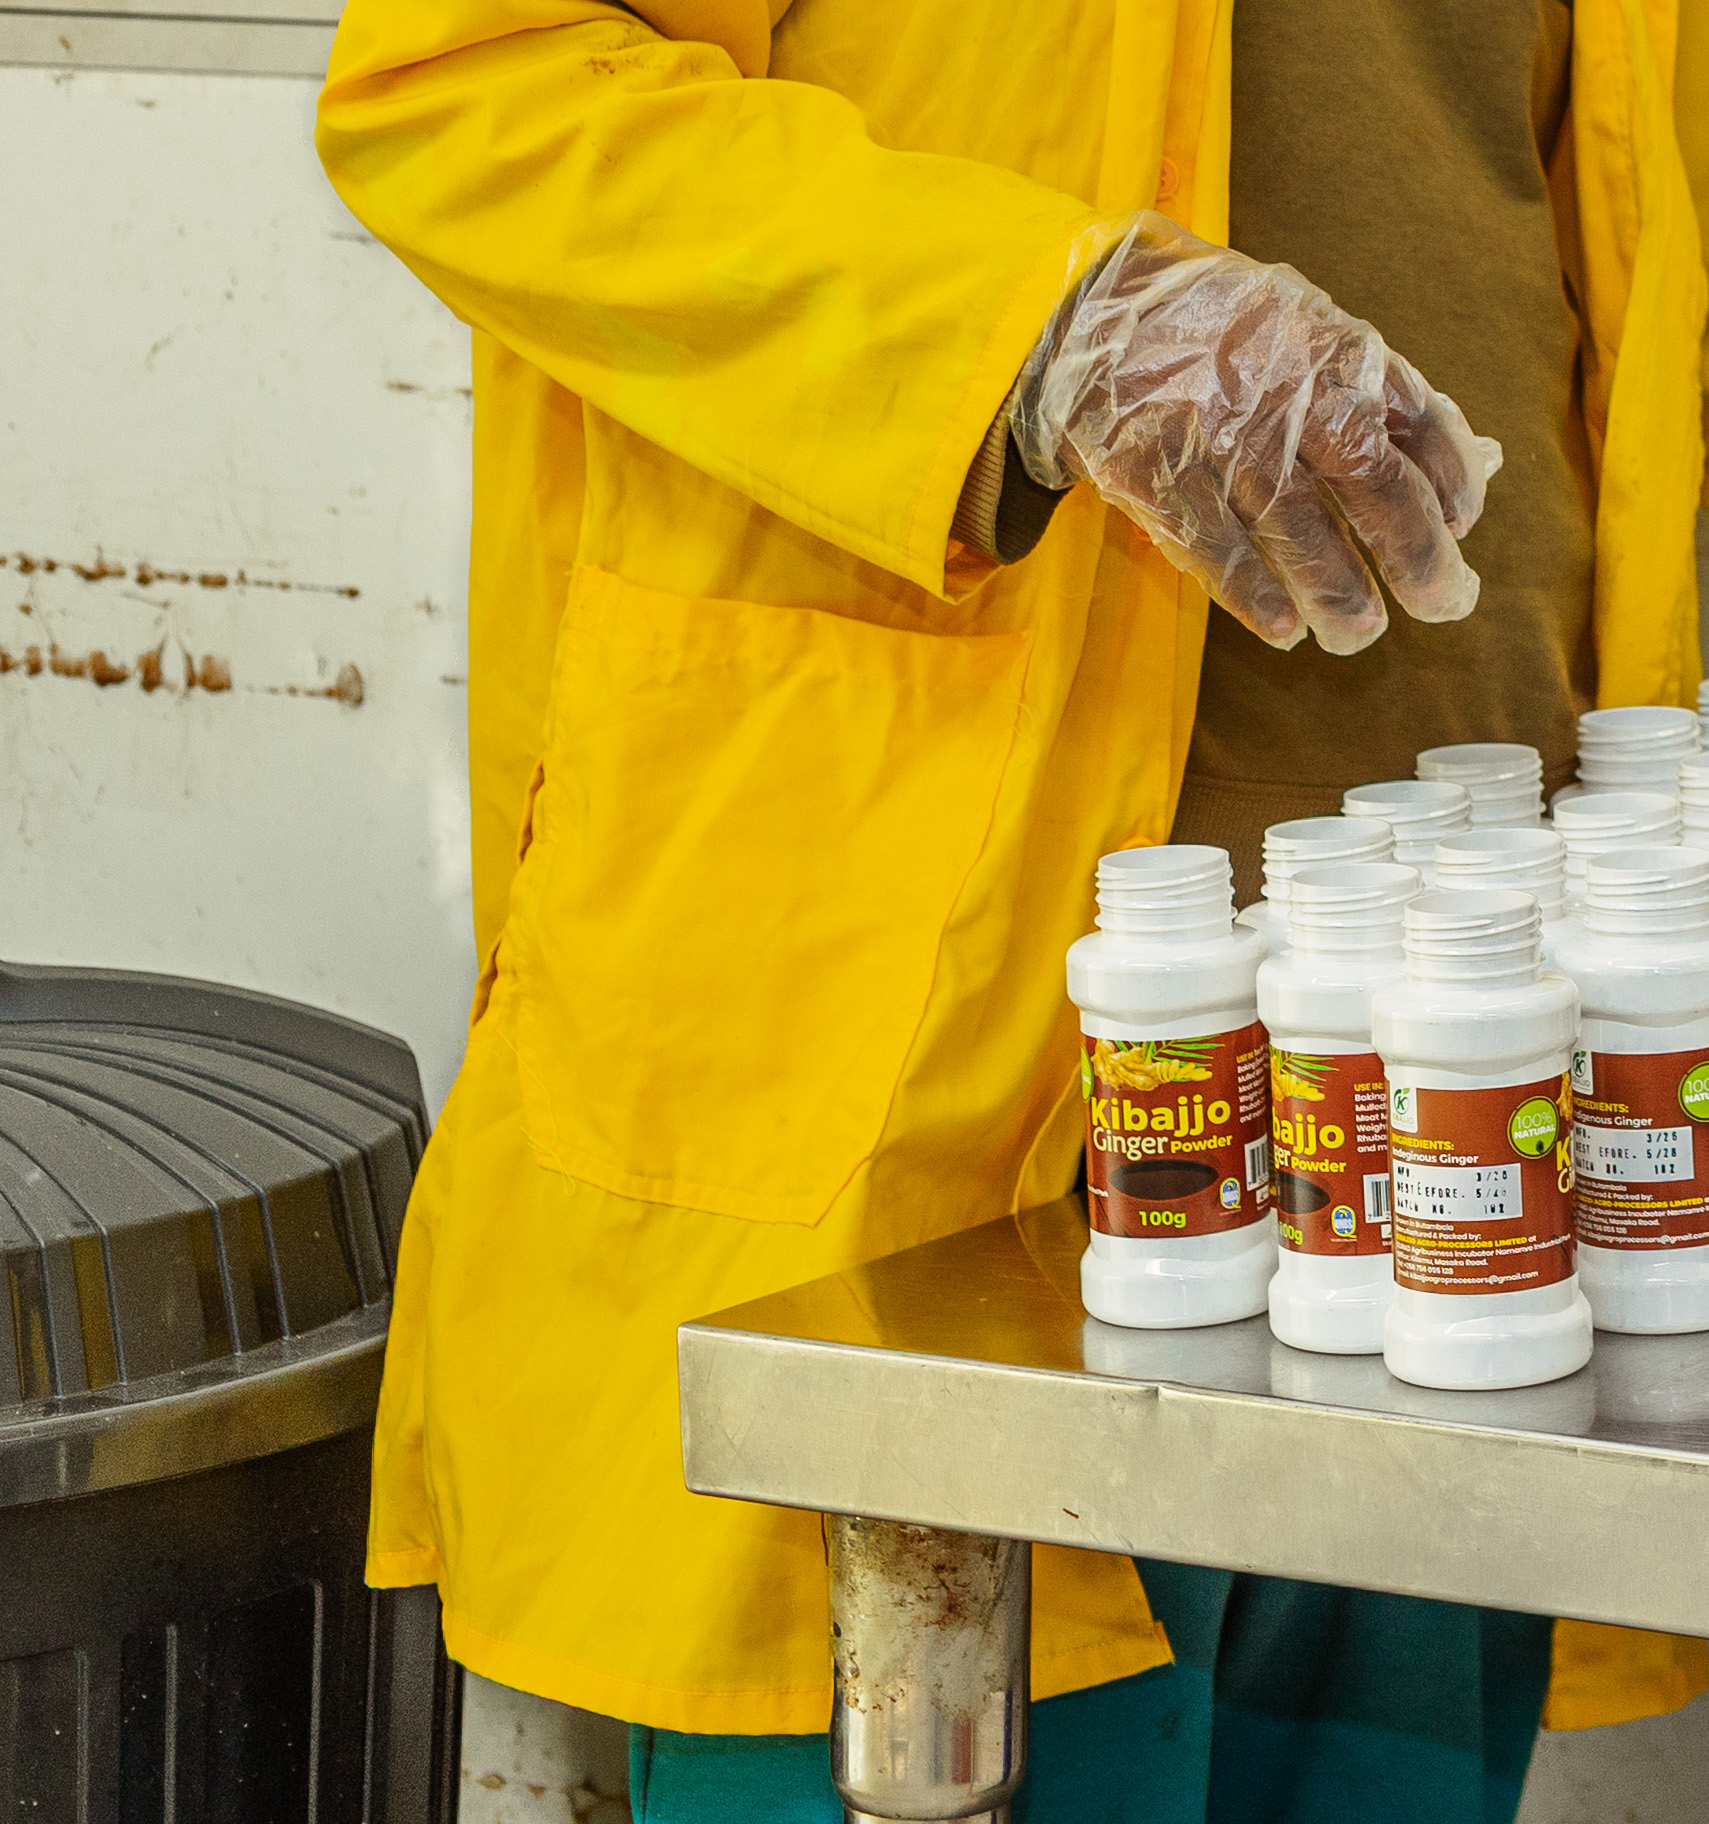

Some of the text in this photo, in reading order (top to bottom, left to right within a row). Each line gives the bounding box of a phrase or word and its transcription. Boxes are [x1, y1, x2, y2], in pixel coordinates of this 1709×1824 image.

[1354, 1082, 1371, 1092] USE
[1354, 1093, 1386, 1103] Baking
[1355, 1103, 1387, 1112] Mulled
[1091, 1094, 1231, 1137] Kibajjo
[1356, 1113, 1379, 1122] Meat
[1516, 1112, 1552, 1130] 100%
[1356, 1123, 1387, 1133] Weigh
[1614, 1116, 1654, 1128] Ginger
[1513, 1123, 1556, 1139] NATURAL
[1093, 1127, 1233, 1161] Ginger Powder
[1357, 1144, 1376, 1153] and
[1291, 1157, 1347, 1173] Powder
[1439, 1153, 1479, 1165] Ginger
[1139, 1211, 1187, 1228] 100g
